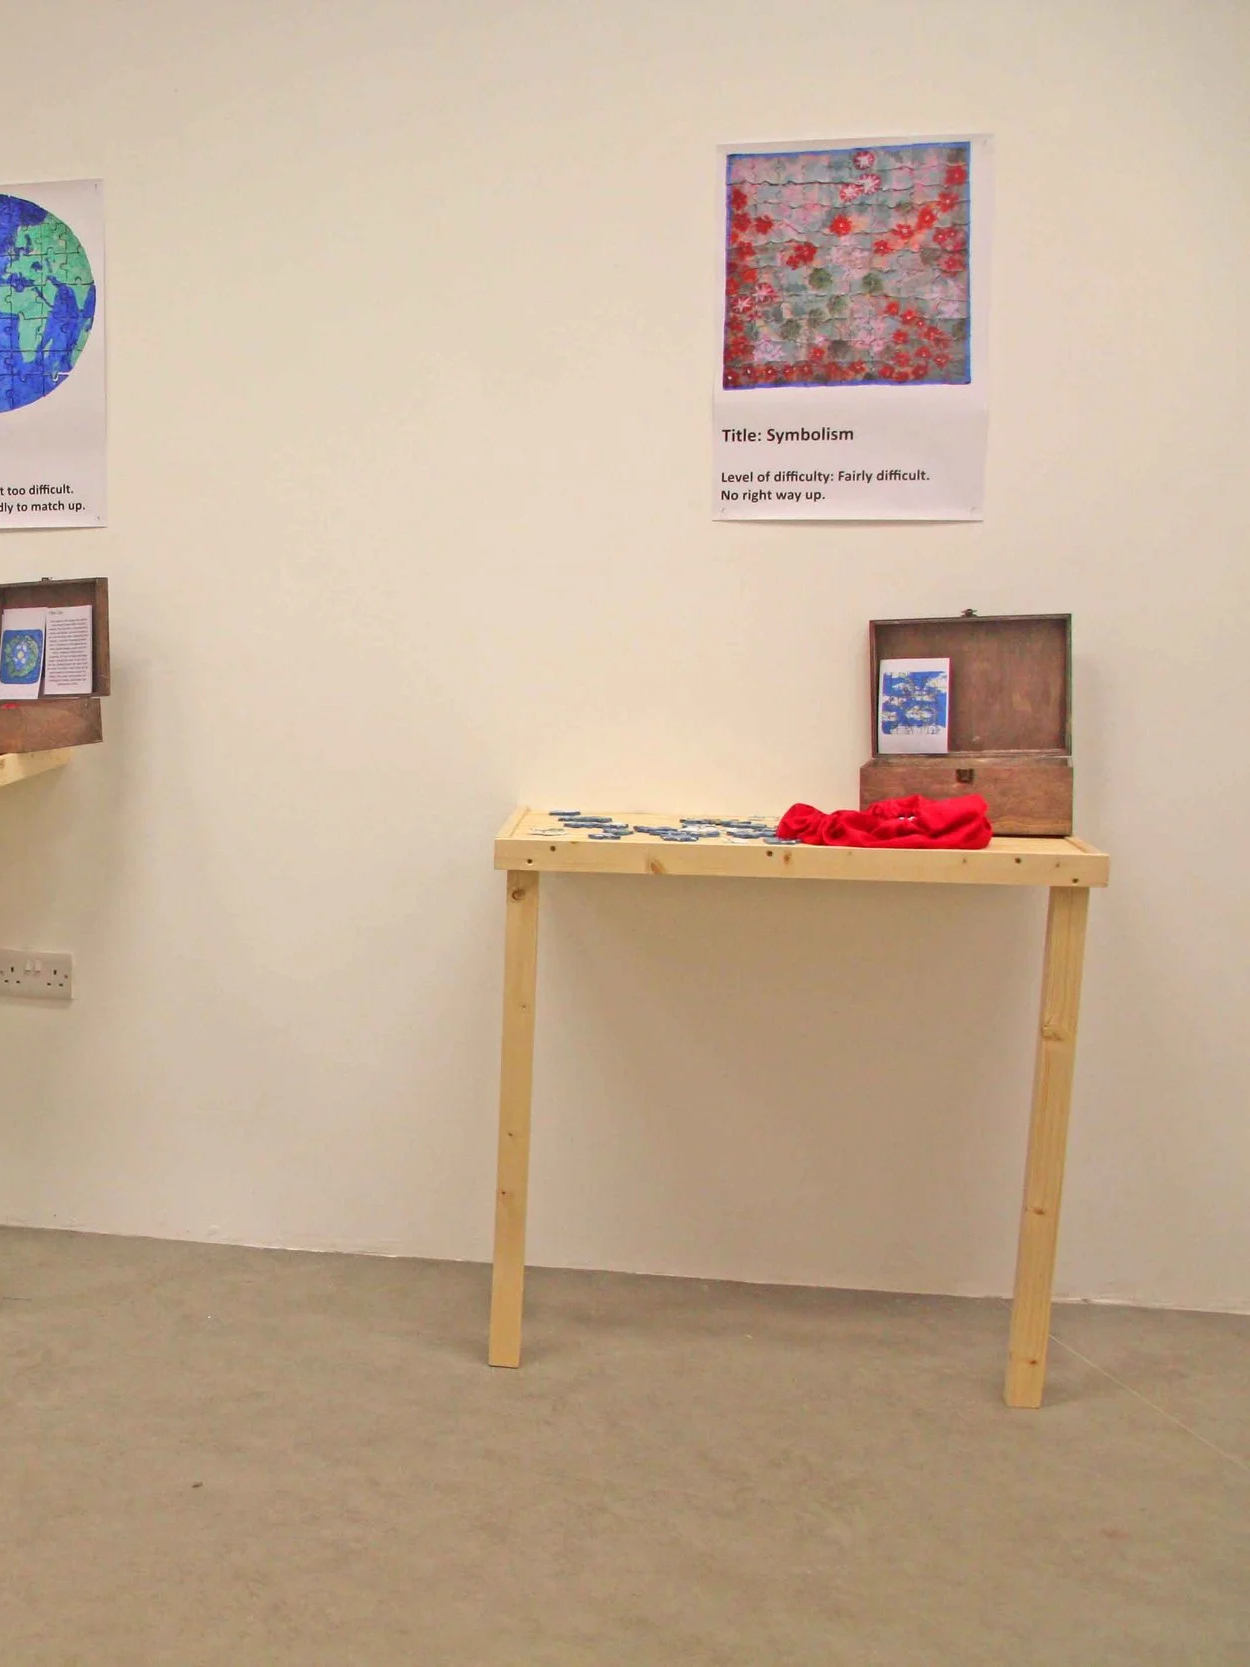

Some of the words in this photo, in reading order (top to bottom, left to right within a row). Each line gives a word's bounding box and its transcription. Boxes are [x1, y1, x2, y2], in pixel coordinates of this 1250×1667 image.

[722, 429, 762, 442] Title:
[767, 427, 854, 444] Symbolism
[721, 472, 753, 483] Level
[757, 471, 770, 482] of
[774, 470, 834, 484] difficulty:
[838, 470, 872, 483] Fairly
[876, 470, 929, 481] difficult.
[8, 487, 25, 496] too
[29, 484, 73, 495] difficult.
[721, 490, 738, 500] No
[743, 489, 772, 502] right
[776, 491, 801, 501] way
[805, 490, 825, 501] up.
[17, 503, 27, 512] to
[31, 501, 64, 512] match
[68, 503, 85, 511] up.
